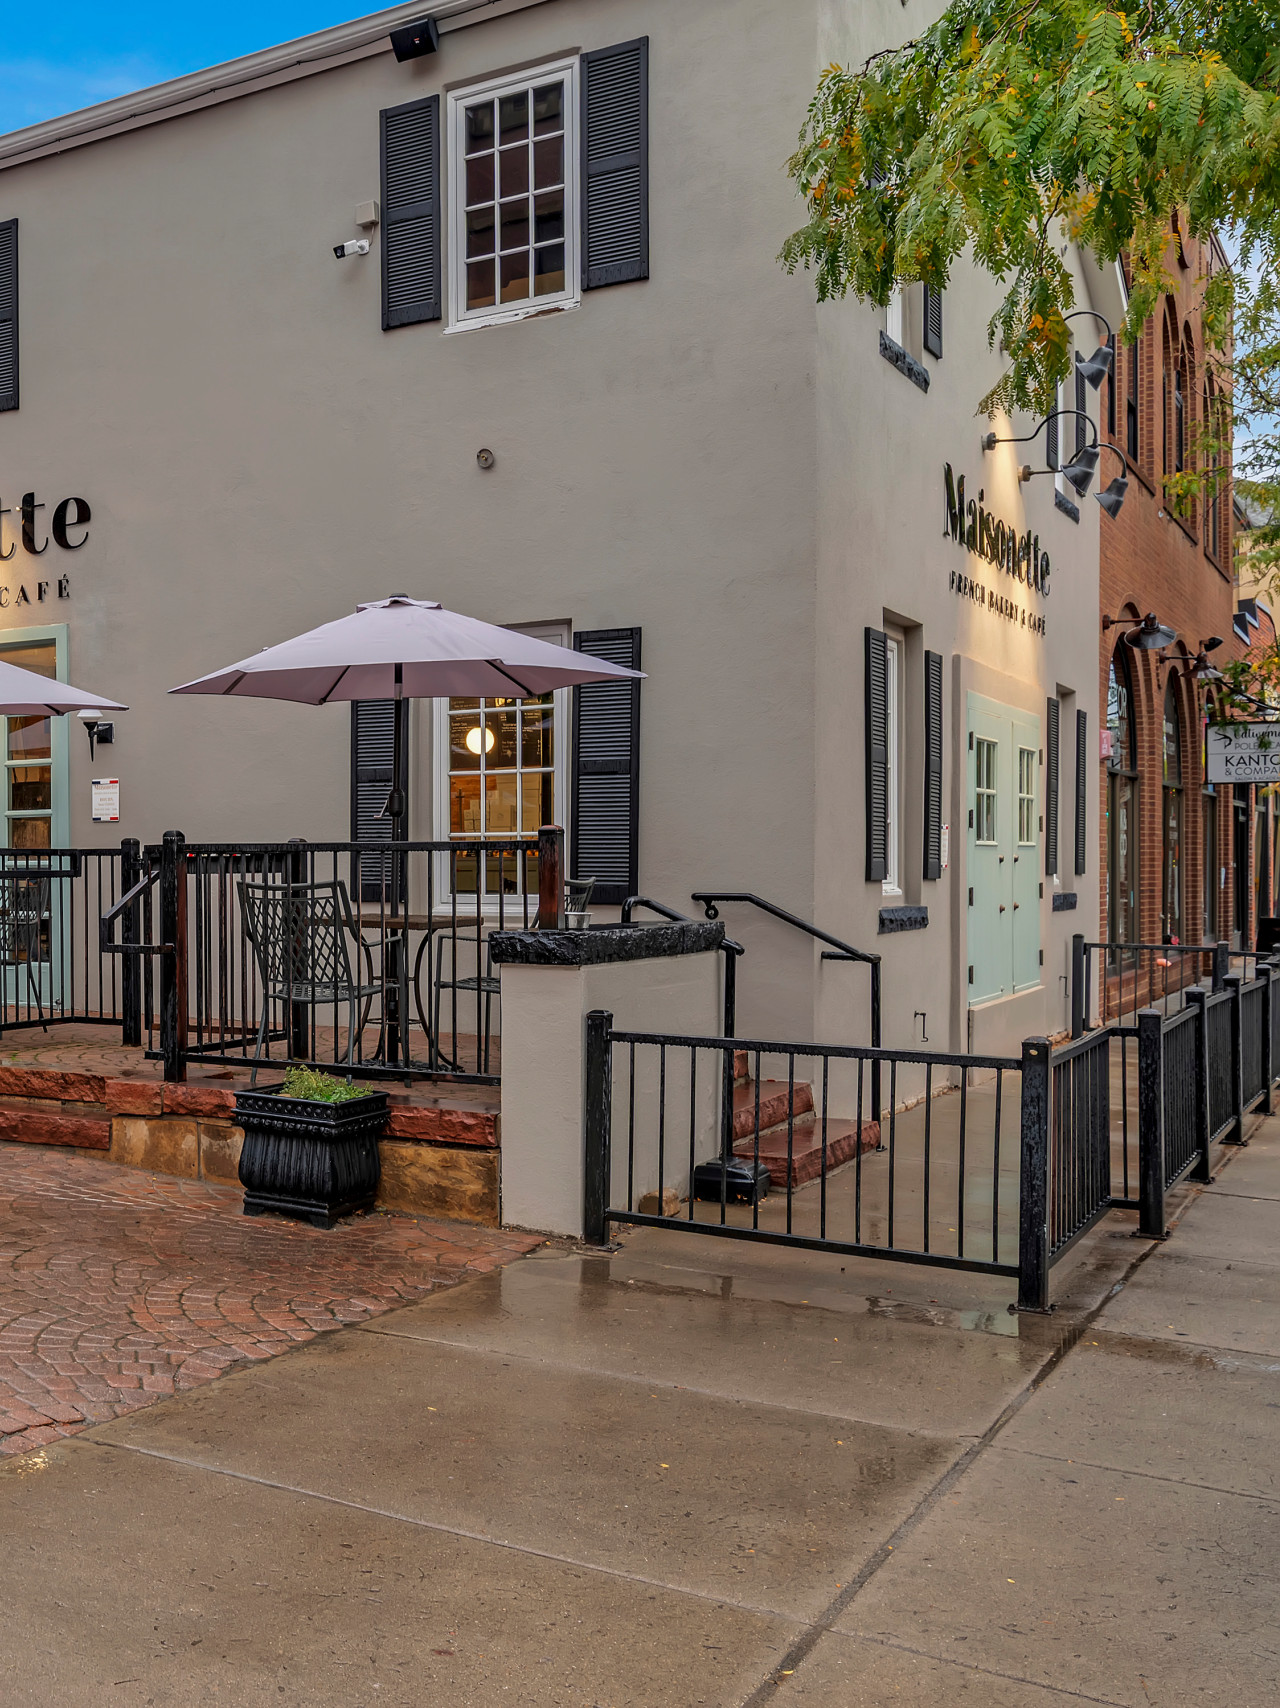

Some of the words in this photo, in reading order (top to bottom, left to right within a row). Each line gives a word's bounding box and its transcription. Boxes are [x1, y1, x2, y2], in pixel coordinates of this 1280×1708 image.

[943, 462, 1051, 597] Maisonette
[949, 570, 986, 607] FRENCH
[987, 590, 1019, 624] BAKERY
[1234, 767, 1280, 776] COMPA
